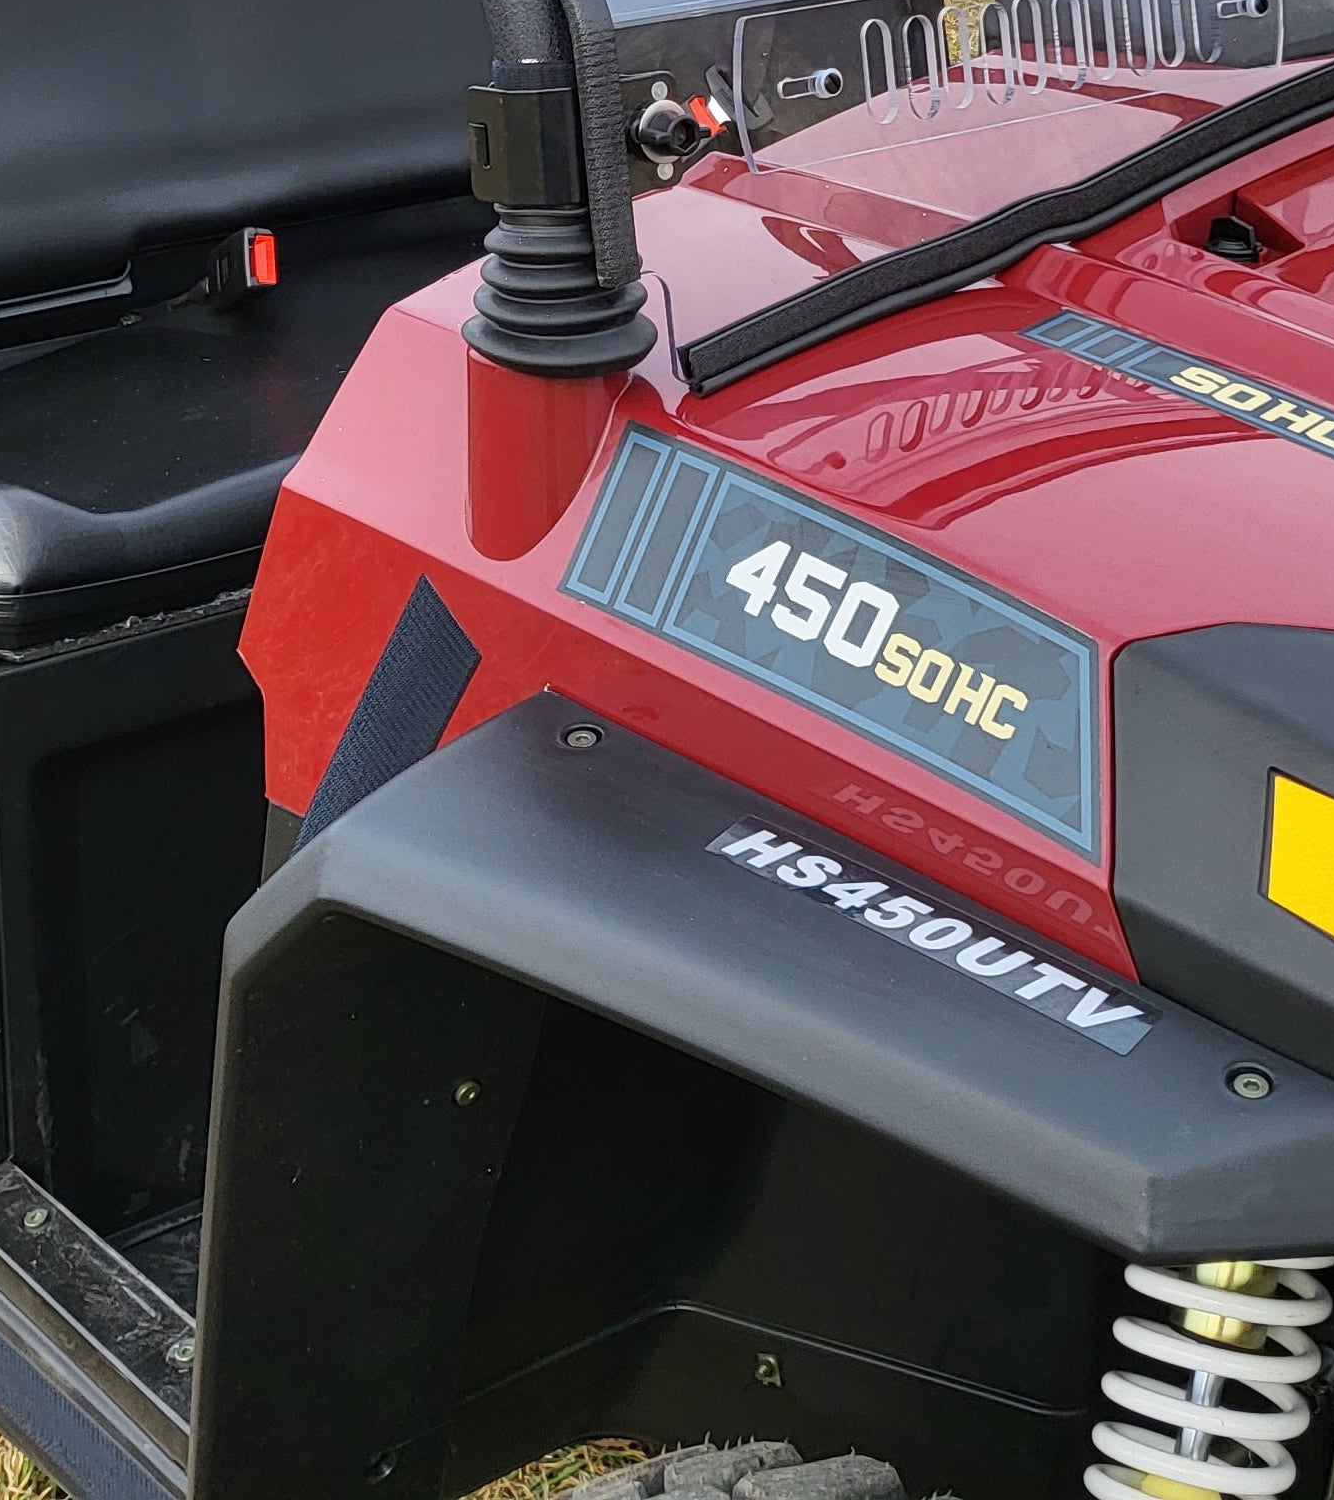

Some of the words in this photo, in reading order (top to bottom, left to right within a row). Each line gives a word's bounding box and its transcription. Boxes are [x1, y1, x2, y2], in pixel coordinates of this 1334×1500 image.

[725, 540, 900, 669] 450
[874, 631, 1029, 741] SOHC
[724, 829, 1146, 1030] HS450UTV
